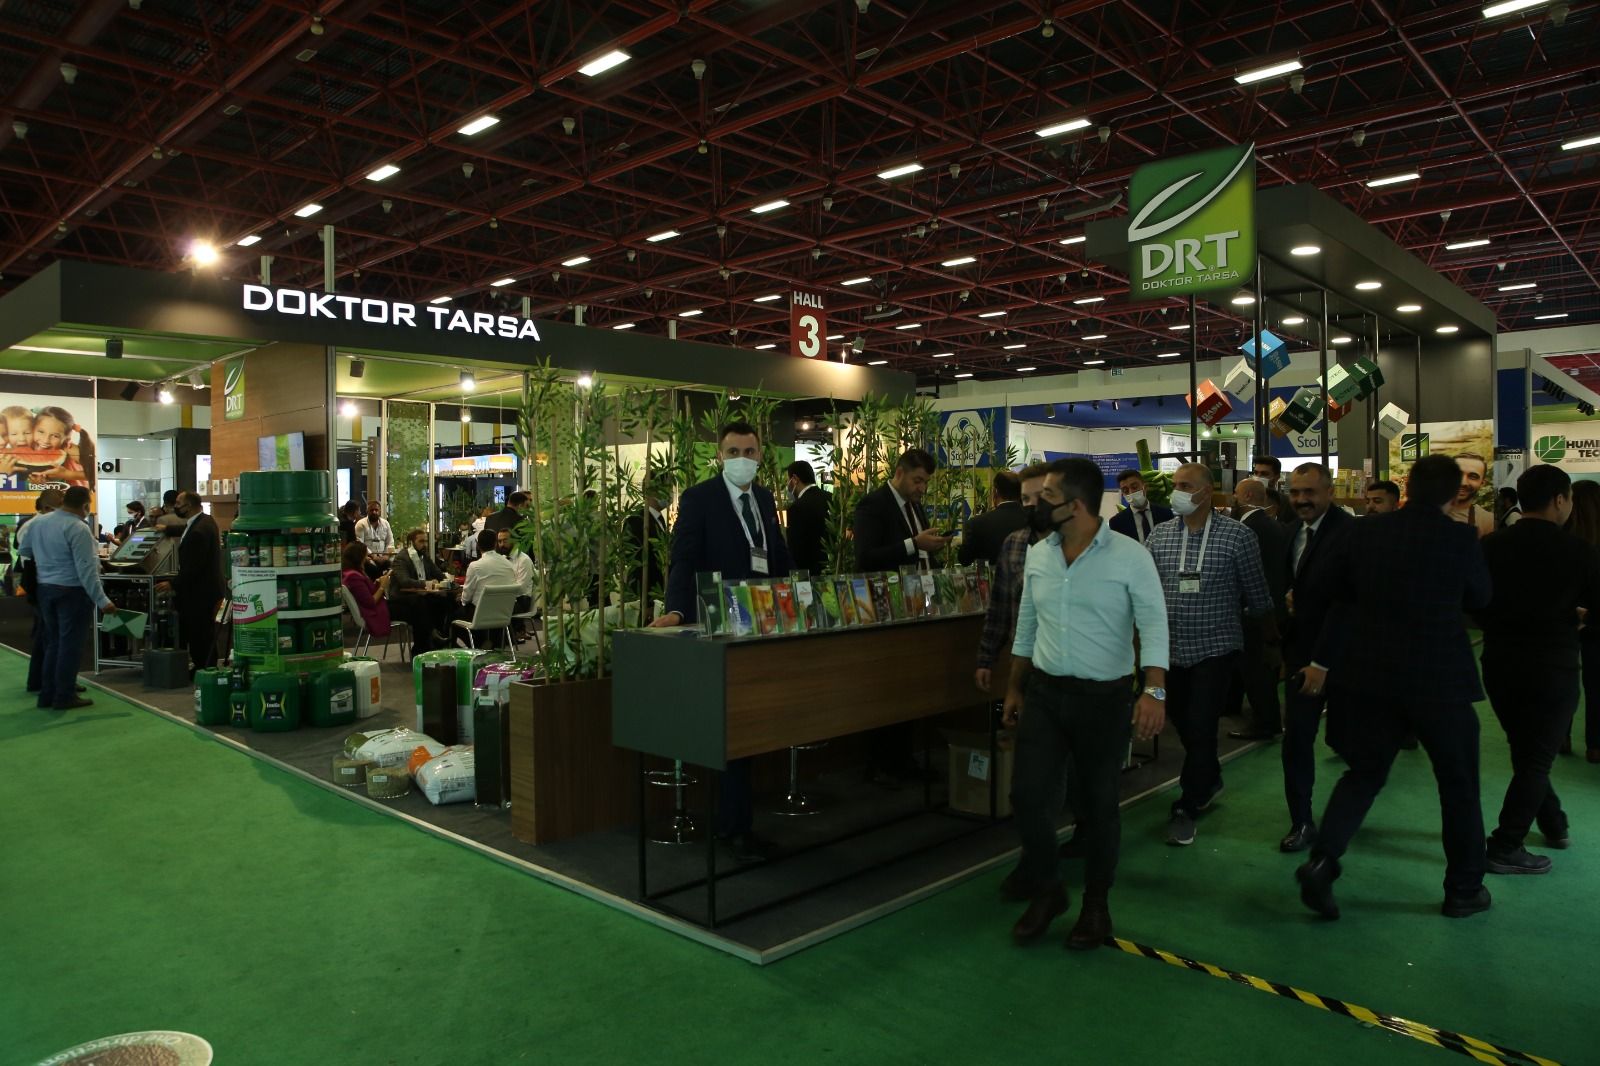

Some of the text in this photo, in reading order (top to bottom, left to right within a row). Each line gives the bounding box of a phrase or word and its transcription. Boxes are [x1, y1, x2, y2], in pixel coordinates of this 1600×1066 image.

[1142, 270, 1240, 291] DOKTOR TARSA
[793, 290, 824, 310] HALL
[243, 284, 541, 342] DOKTOR TARSA
[798, 314, 820, 357] 3
[226, 394, 242, 412] DRT
[1297, 434, 1338, 448] Stolr
[0, 473, 18, 489] F1
